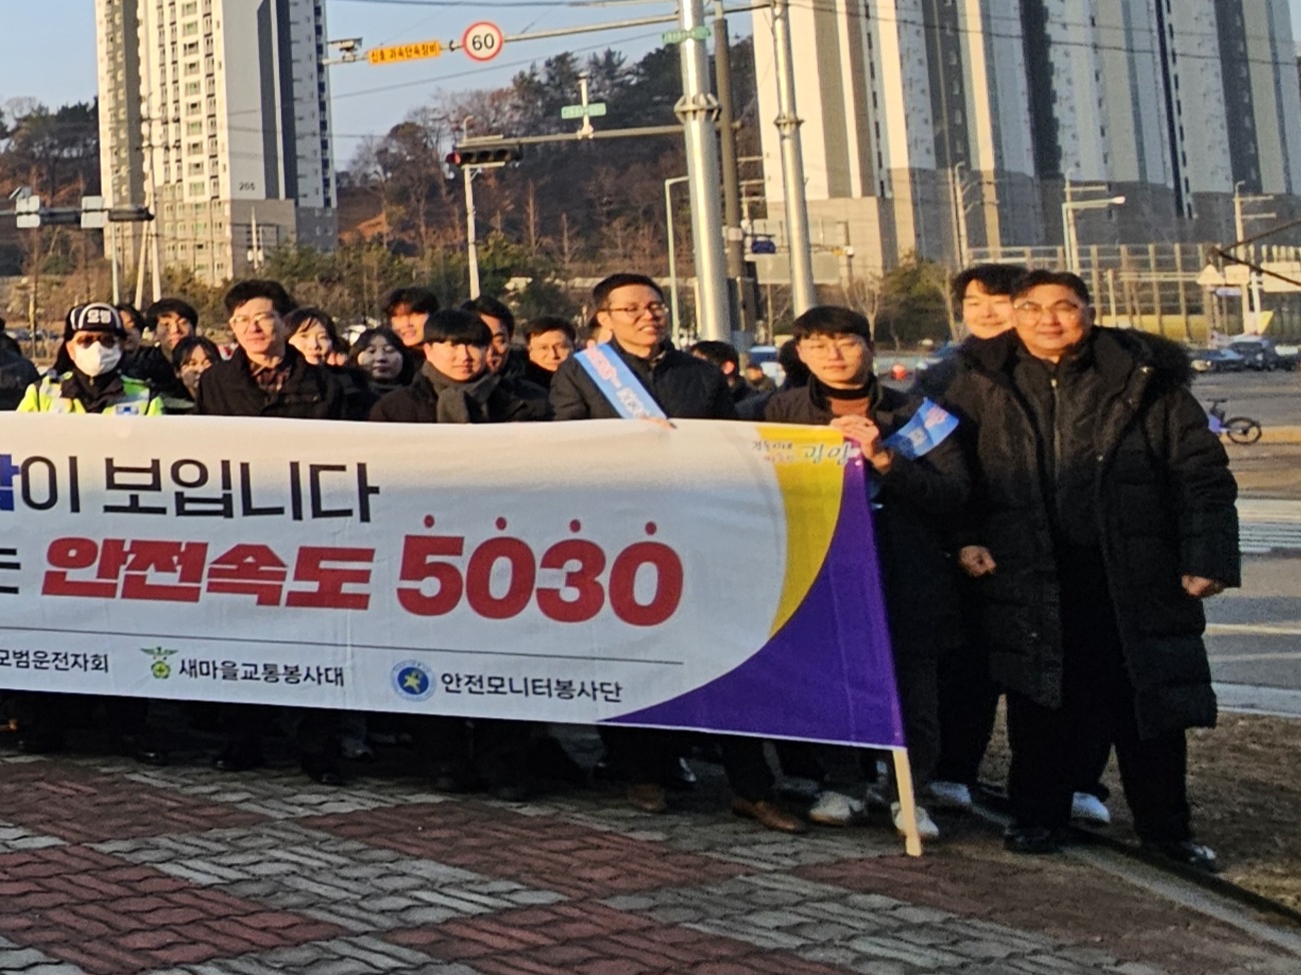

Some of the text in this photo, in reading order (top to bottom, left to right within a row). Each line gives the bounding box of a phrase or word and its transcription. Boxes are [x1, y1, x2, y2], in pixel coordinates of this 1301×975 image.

[472, 33, 495, 51] 60
[102, 456, 380, 525] 보입니다
[40, 534, 376, 611] 안전속도
[396, 533, 685, 627] 5030
[177, 658, 345, 688] 새마을교통봉사대
[440, 672, 624, 704] 안전모니터봉사단
